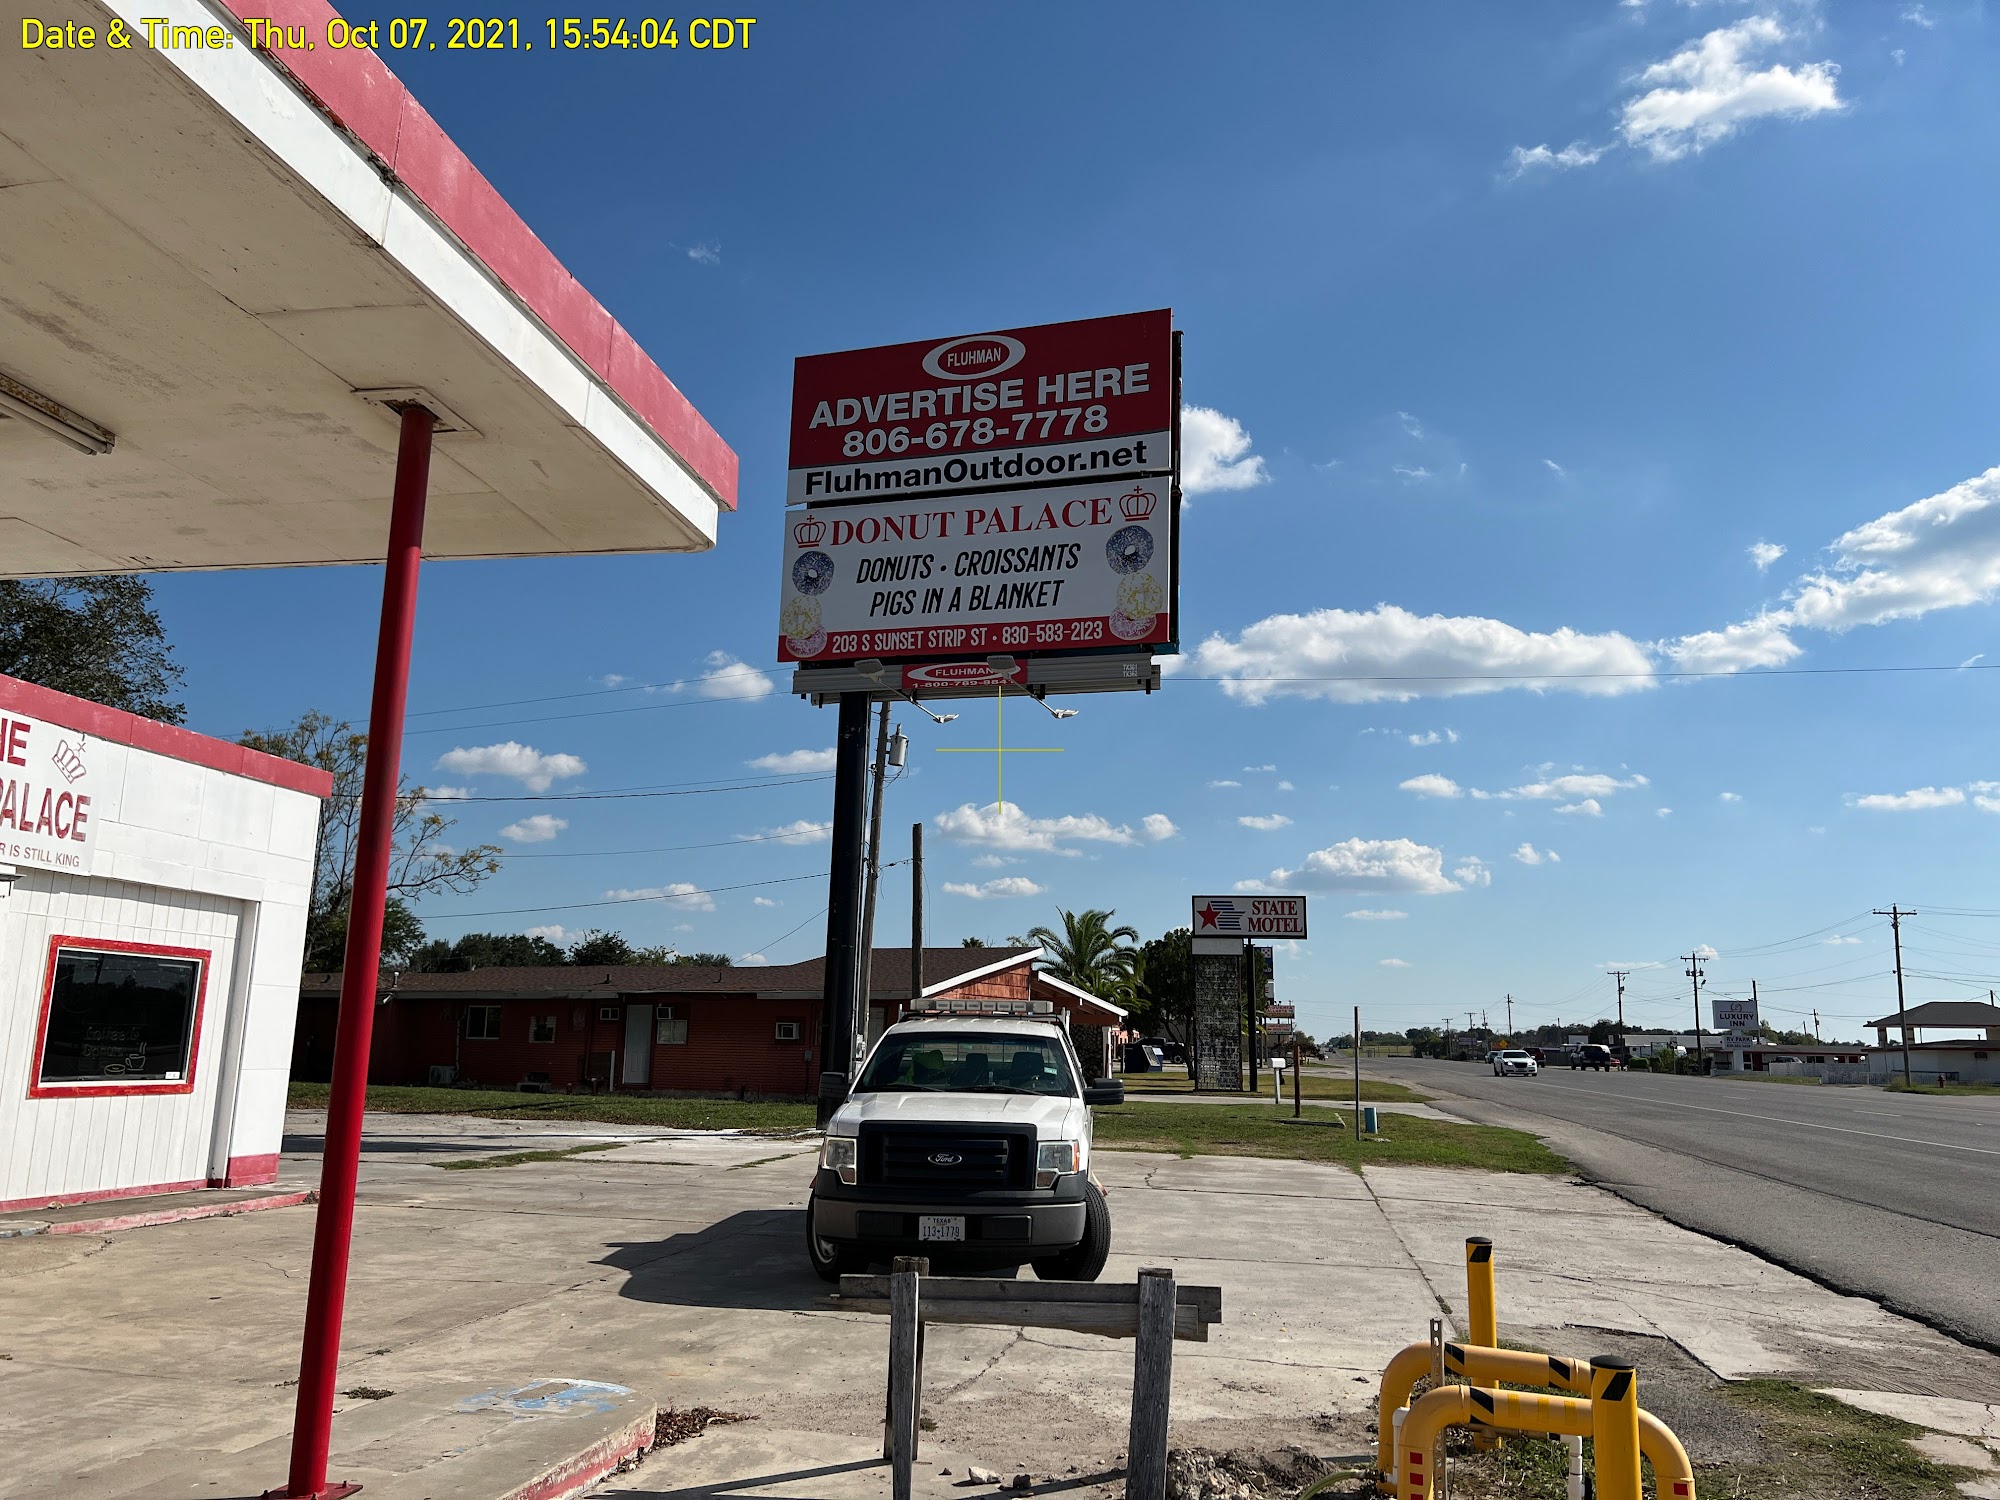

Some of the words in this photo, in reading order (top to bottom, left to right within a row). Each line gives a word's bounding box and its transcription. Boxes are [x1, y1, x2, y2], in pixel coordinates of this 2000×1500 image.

[947, 347, 1001, 368] FLUHMAN
[808, 378, 1024, 429] ADVERTISE
[1037, 362, 1150, 405] HERE
[842, 404, 1108, 457] 806-678-7778
[805, 440, 1147, 496] FluhmanOutdoor.net
[830, 511, 956, 546] DONUT
[964, 497, 1112, 536] PALACE
[856, 553, 934, 584] DONUTS
[954, 543, 1081, 577] CROISSANTS
[869, 589, 917, 617] PIGS
[921, 588, 944, 614] IN
[948, 586, 962, 612] A
[968, 579, 1065, 612] BLANKET
[832, 634, 858, 653] 203
[861, 633, 870, 651] S
[874, 630, 924, 651] SUNSET
[928, 628, 966, 648] STRIP
[971, 627, 987, 646] ST
[1002, 620, 1103, 645] 830-583-2123
[0, 778, 91, 842] ALACE
[9, 844, 21, 858] IS
[24, 847, 52, 863] STILL
[55, 852, 80, 868] KING
[1247, 917, 1302, 933] MOTEL
[1251, 900, 1298, 916] STATE
[935, 1153, 954, 1163] Ford
